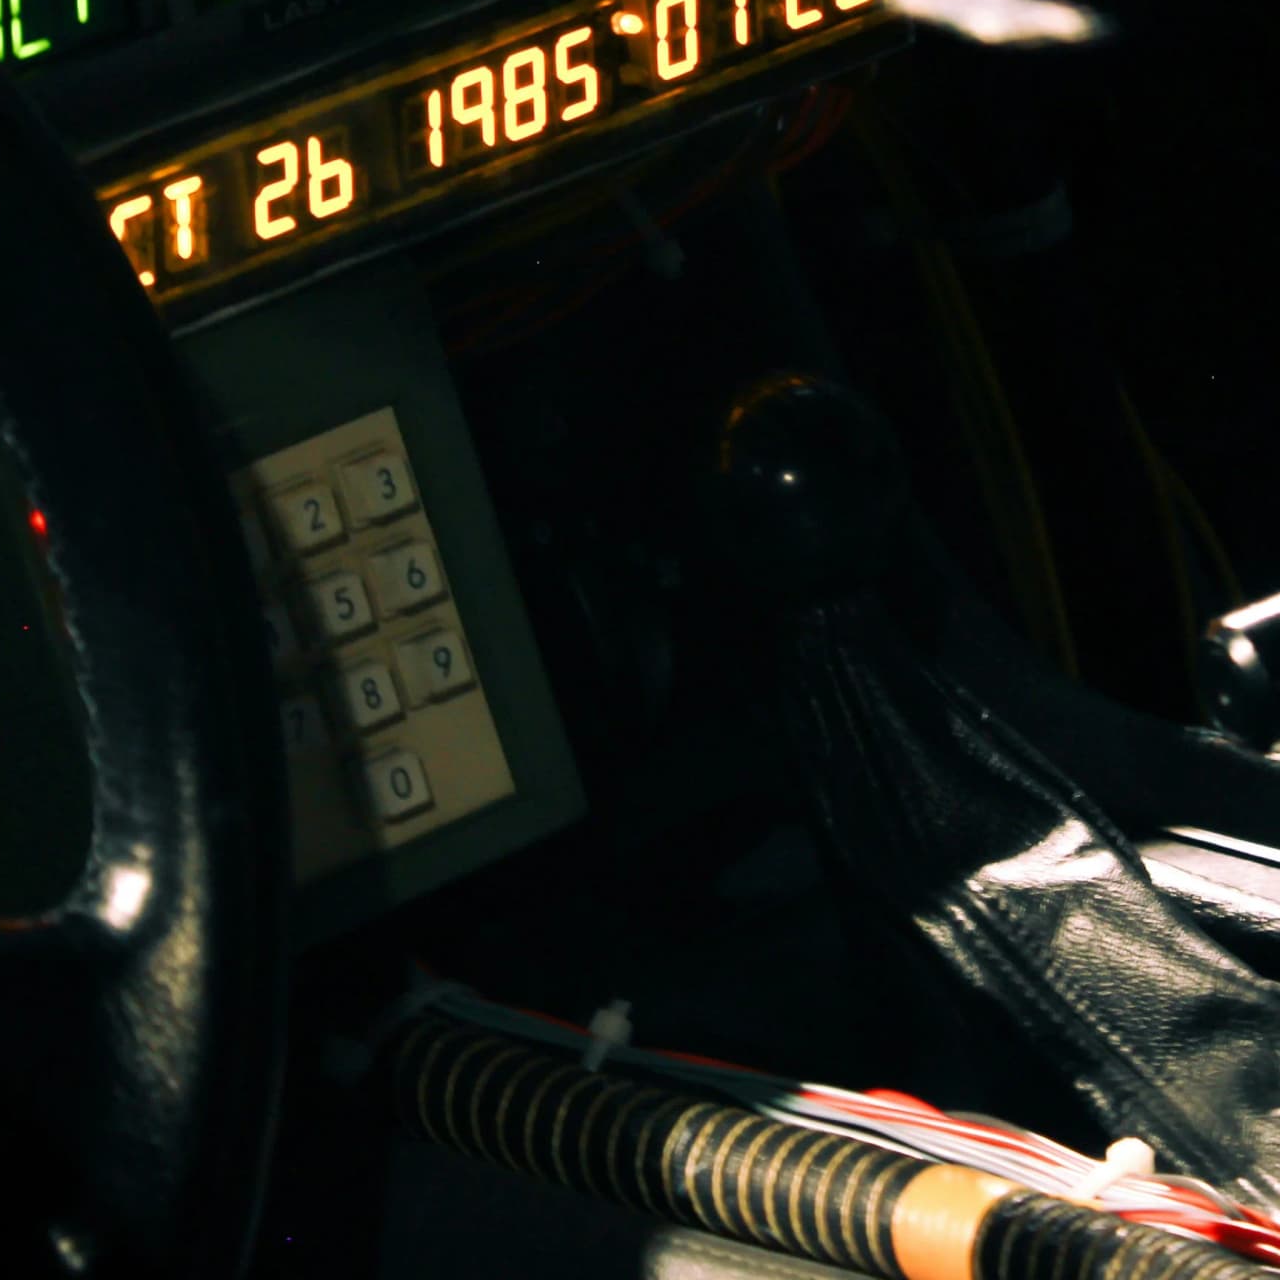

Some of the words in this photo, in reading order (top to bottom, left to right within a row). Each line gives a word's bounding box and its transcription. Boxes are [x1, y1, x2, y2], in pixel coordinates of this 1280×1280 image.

[253, 134, 355, 241] 26
[426, 25, 599, 170] 1985
[303, 498, 328, 532] 2
[376, 468, 397, 500] 3
[334, 585, 355, 620] 5
[407, 558, 427, 590] 6
[363, 677, 383, 711] 8
[433, 646, 453, 679] 9
[390, 766, 413, 799] 0
